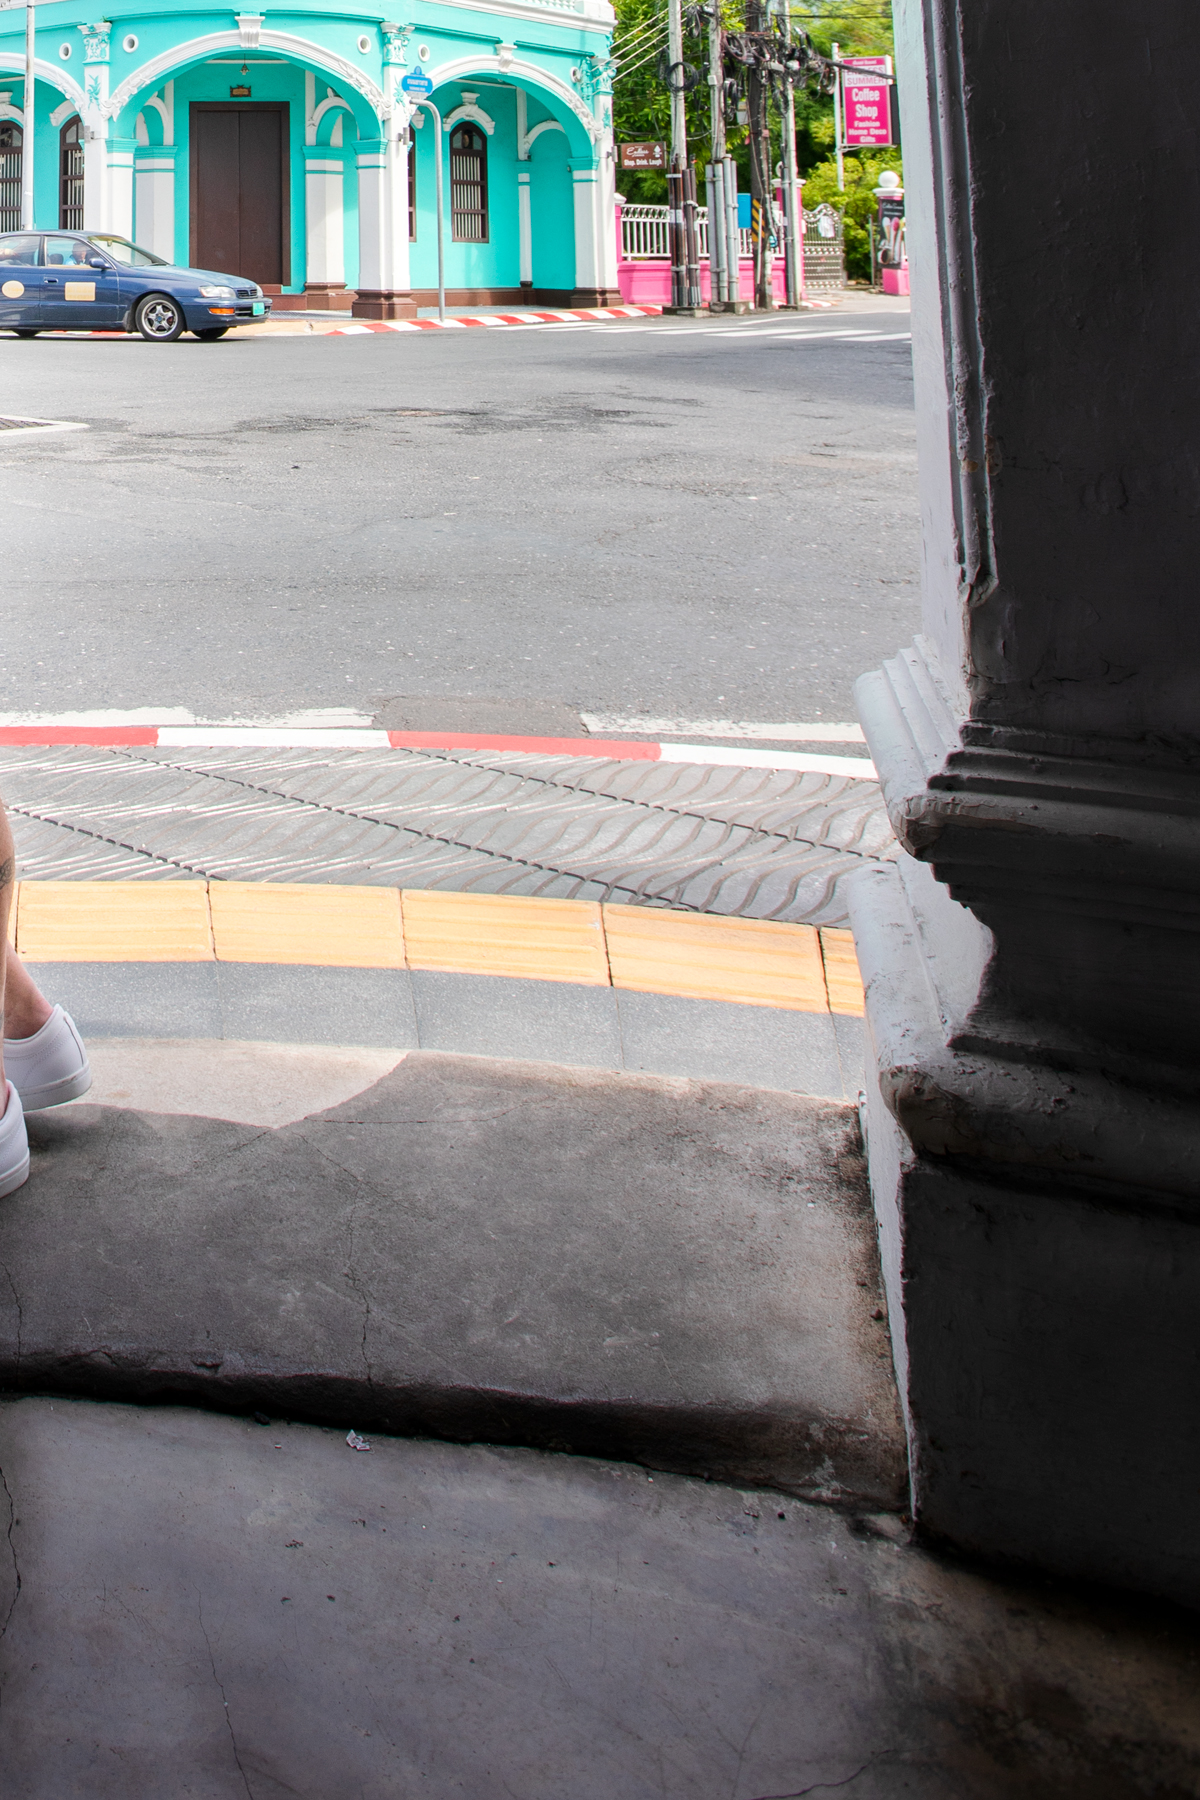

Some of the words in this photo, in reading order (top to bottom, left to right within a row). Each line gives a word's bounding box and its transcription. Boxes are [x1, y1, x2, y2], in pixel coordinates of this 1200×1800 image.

[847, 77, 884, 86] SUMMER
[852, 88, 880, 102] Coffee
[855, 104, 878, 119] Shop
